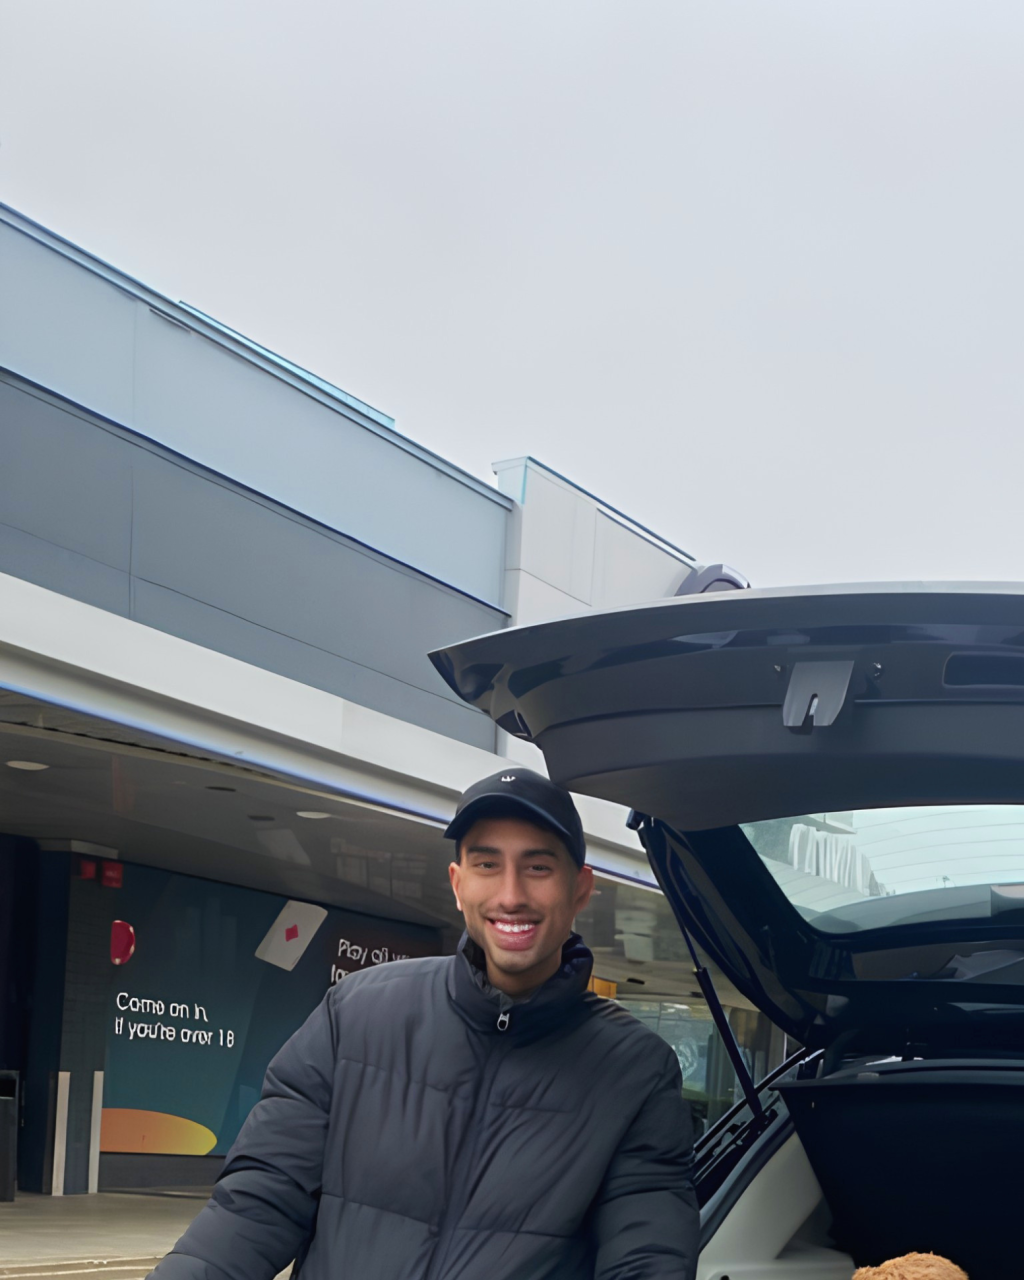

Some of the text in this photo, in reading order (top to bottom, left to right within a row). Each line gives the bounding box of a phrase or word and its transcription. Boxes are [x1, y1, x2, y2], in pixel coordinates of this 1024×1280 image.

[116, 992, 165, 1016] Come
[169, 1002, 189, 1019] on
[128, 1021, 176, 1041] you're
[180, 1028, 214, 1046] over
[218, 1028, 235, 1048] 18
